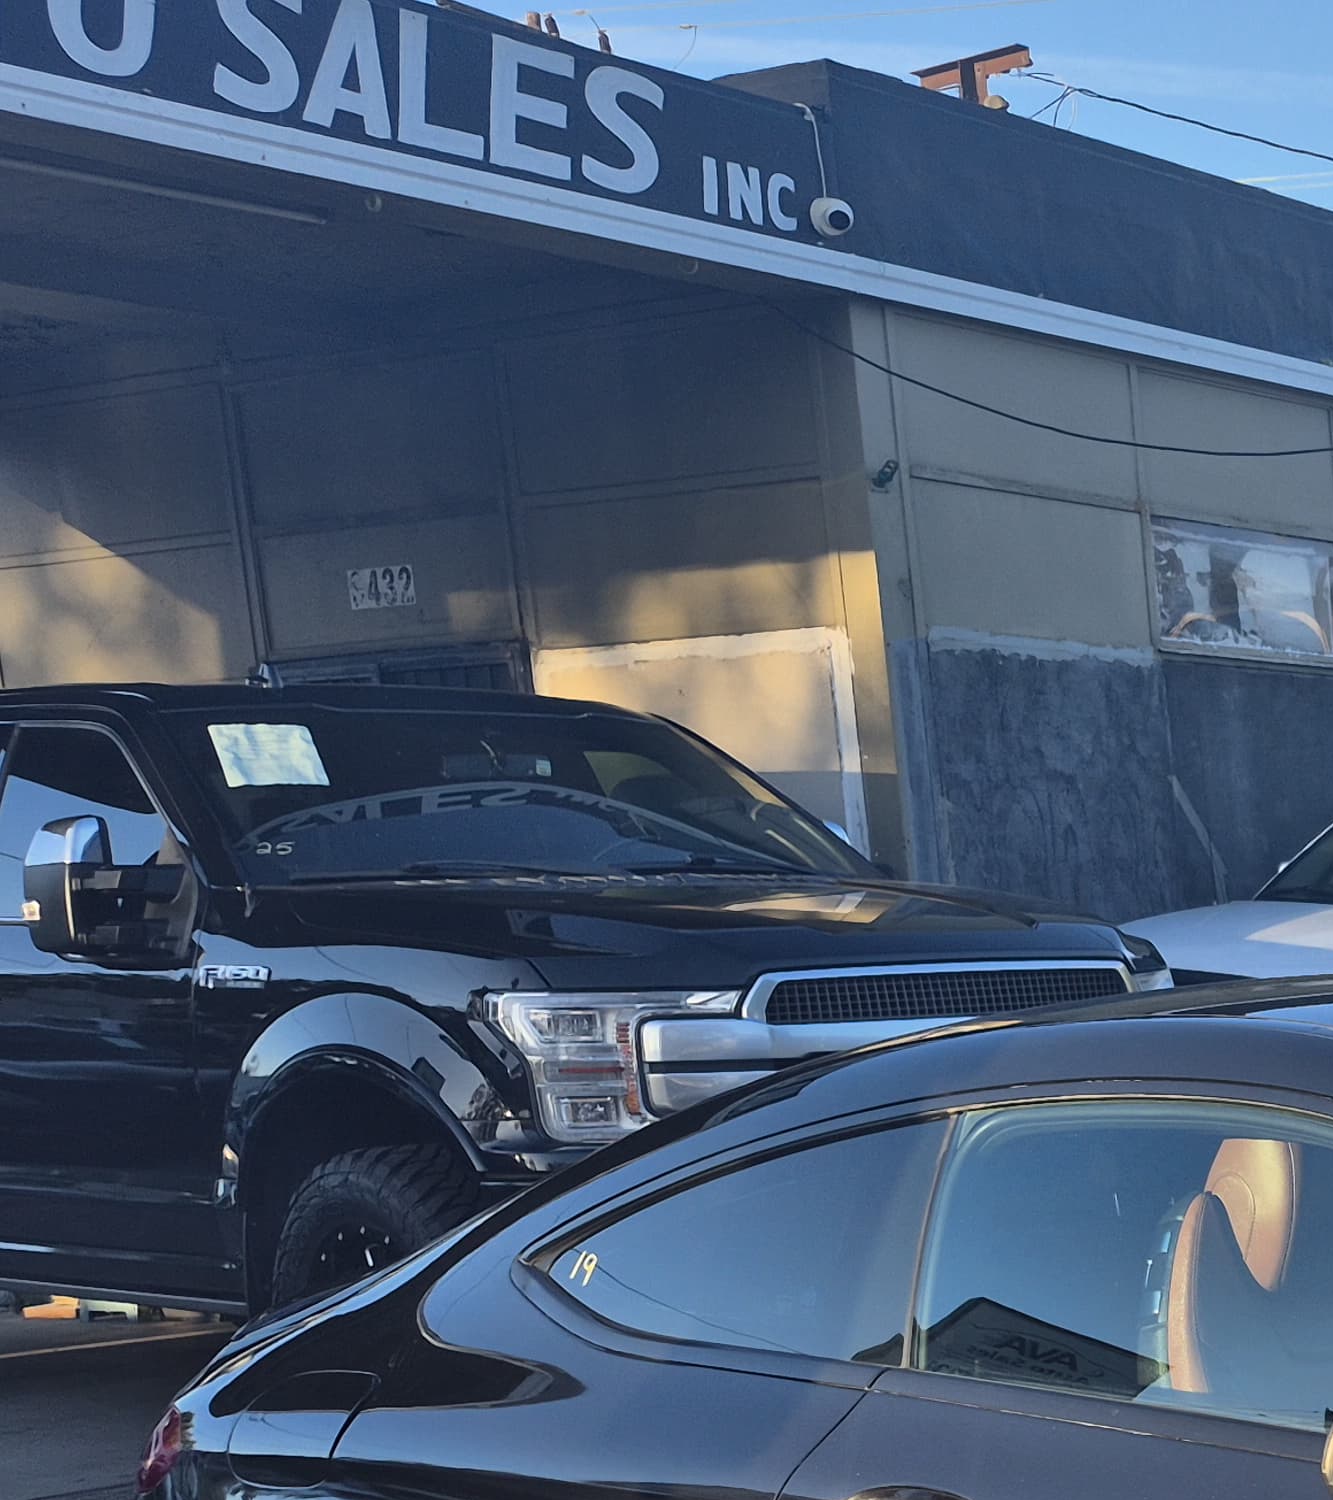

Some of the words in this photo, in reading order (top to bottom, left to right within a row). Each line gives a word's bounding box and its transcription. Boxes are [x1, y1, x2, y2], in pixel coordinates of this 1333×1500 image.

[213, 0, 664, 193] SALES
[702, 155, 797, 231] INC
[255, 841, 296, 856] 25
[569, 1250, 598, 1287] 19
